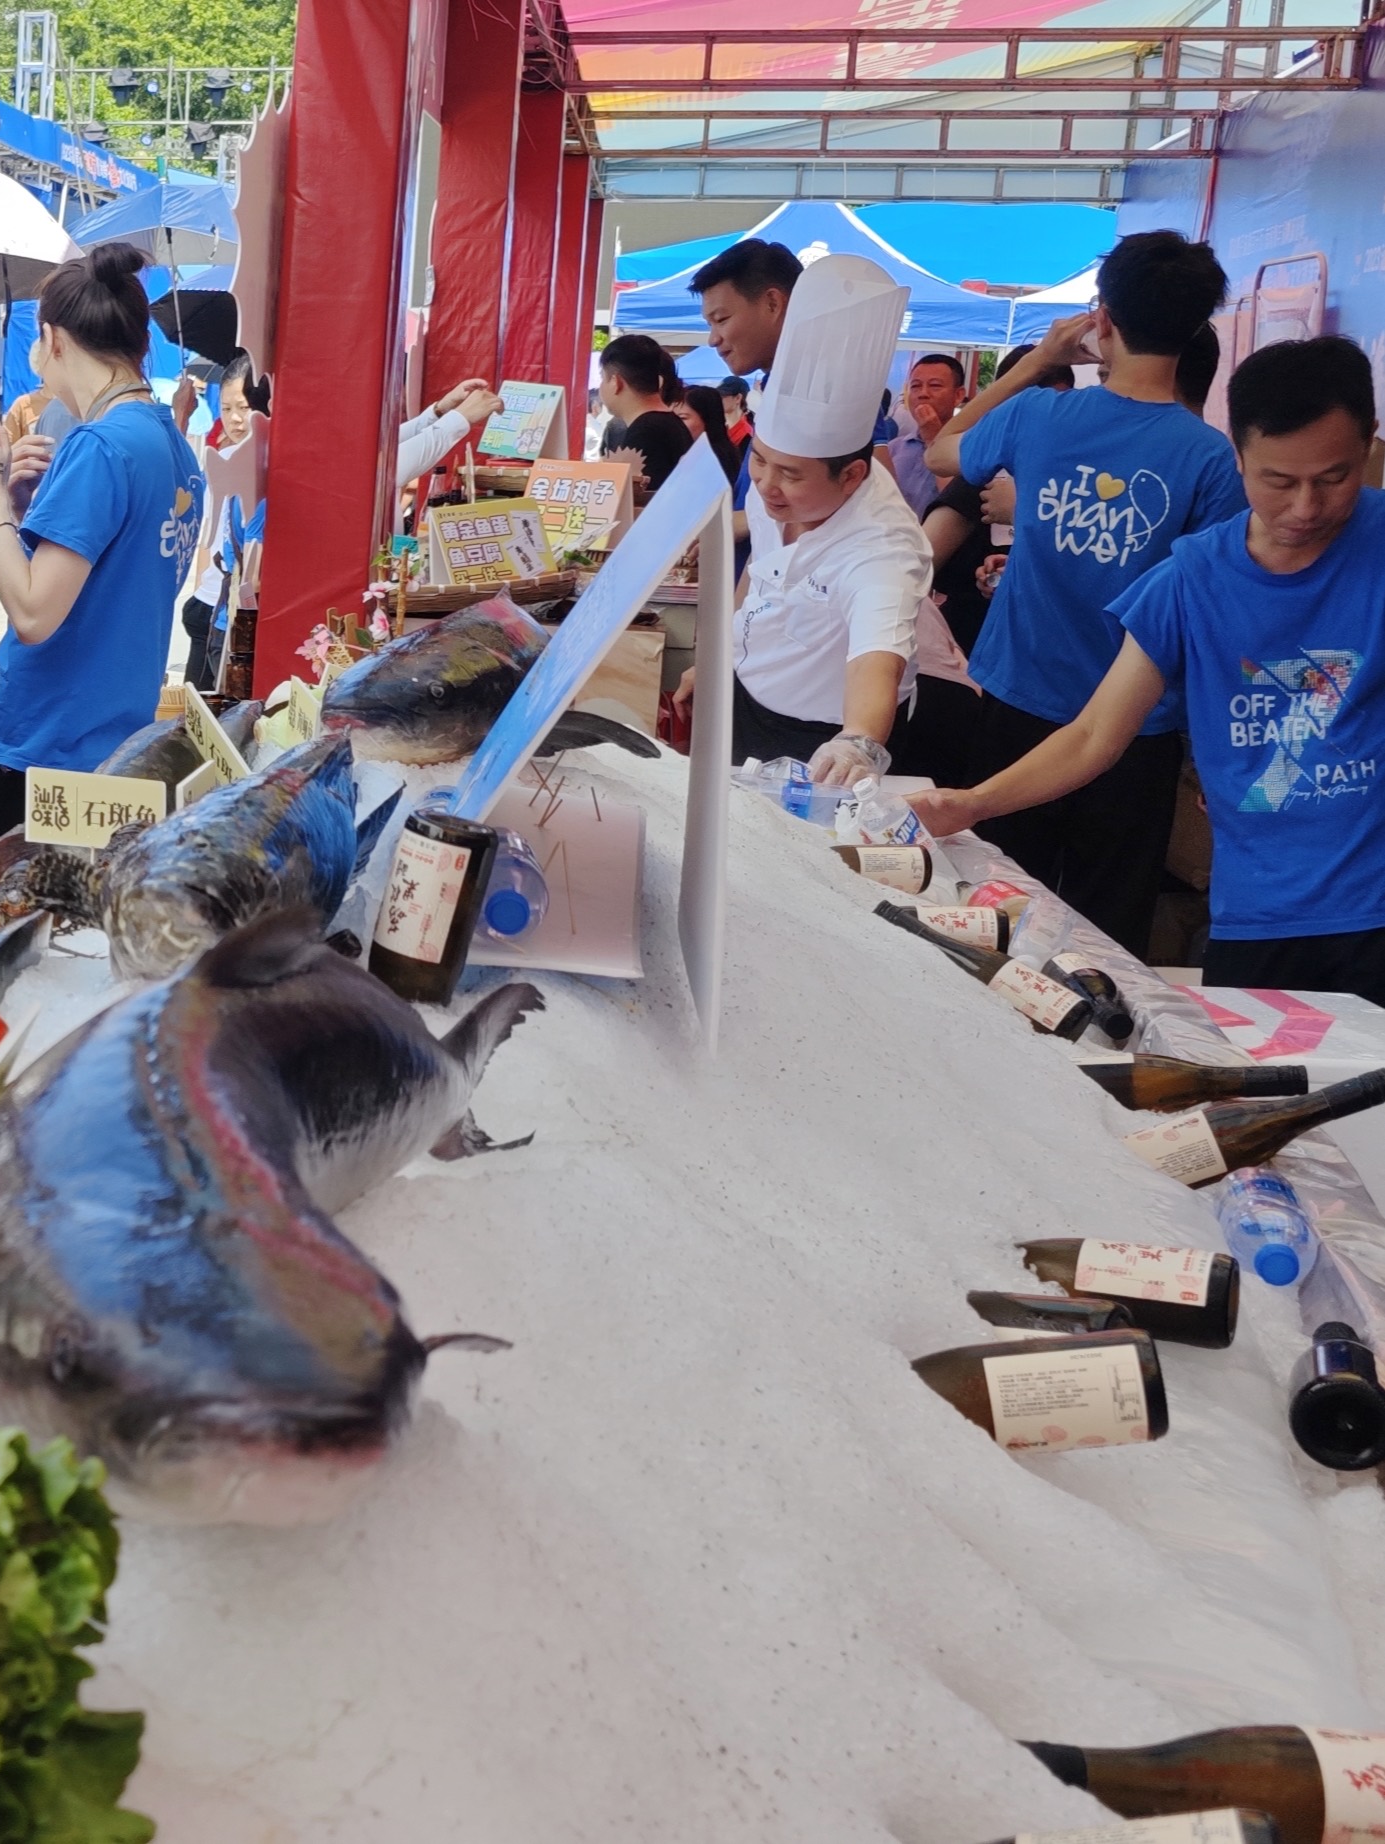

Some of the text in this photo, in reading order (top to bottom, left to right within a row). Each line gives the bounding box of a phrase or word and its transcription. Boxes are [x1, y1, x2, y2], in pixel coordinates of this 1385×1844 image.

[529, 477, 614, 504] 全场丸子
[1071, 464, 1096, 497] I
[439, 514, 512, 543] 黄金鱼蛋
[537, 503, 609, 535] 二送一
[448, 541, 504, 569] 鱼豆腐
[453, 565, 512, 584] 买一送一
[1229, 692, 1329, 719] OFF THE
[1229, 716, 1326, 747] BEATEN
[1315, 759, 1376, 785] PATH
[81, 800, 156, 828] 石斑鱼
